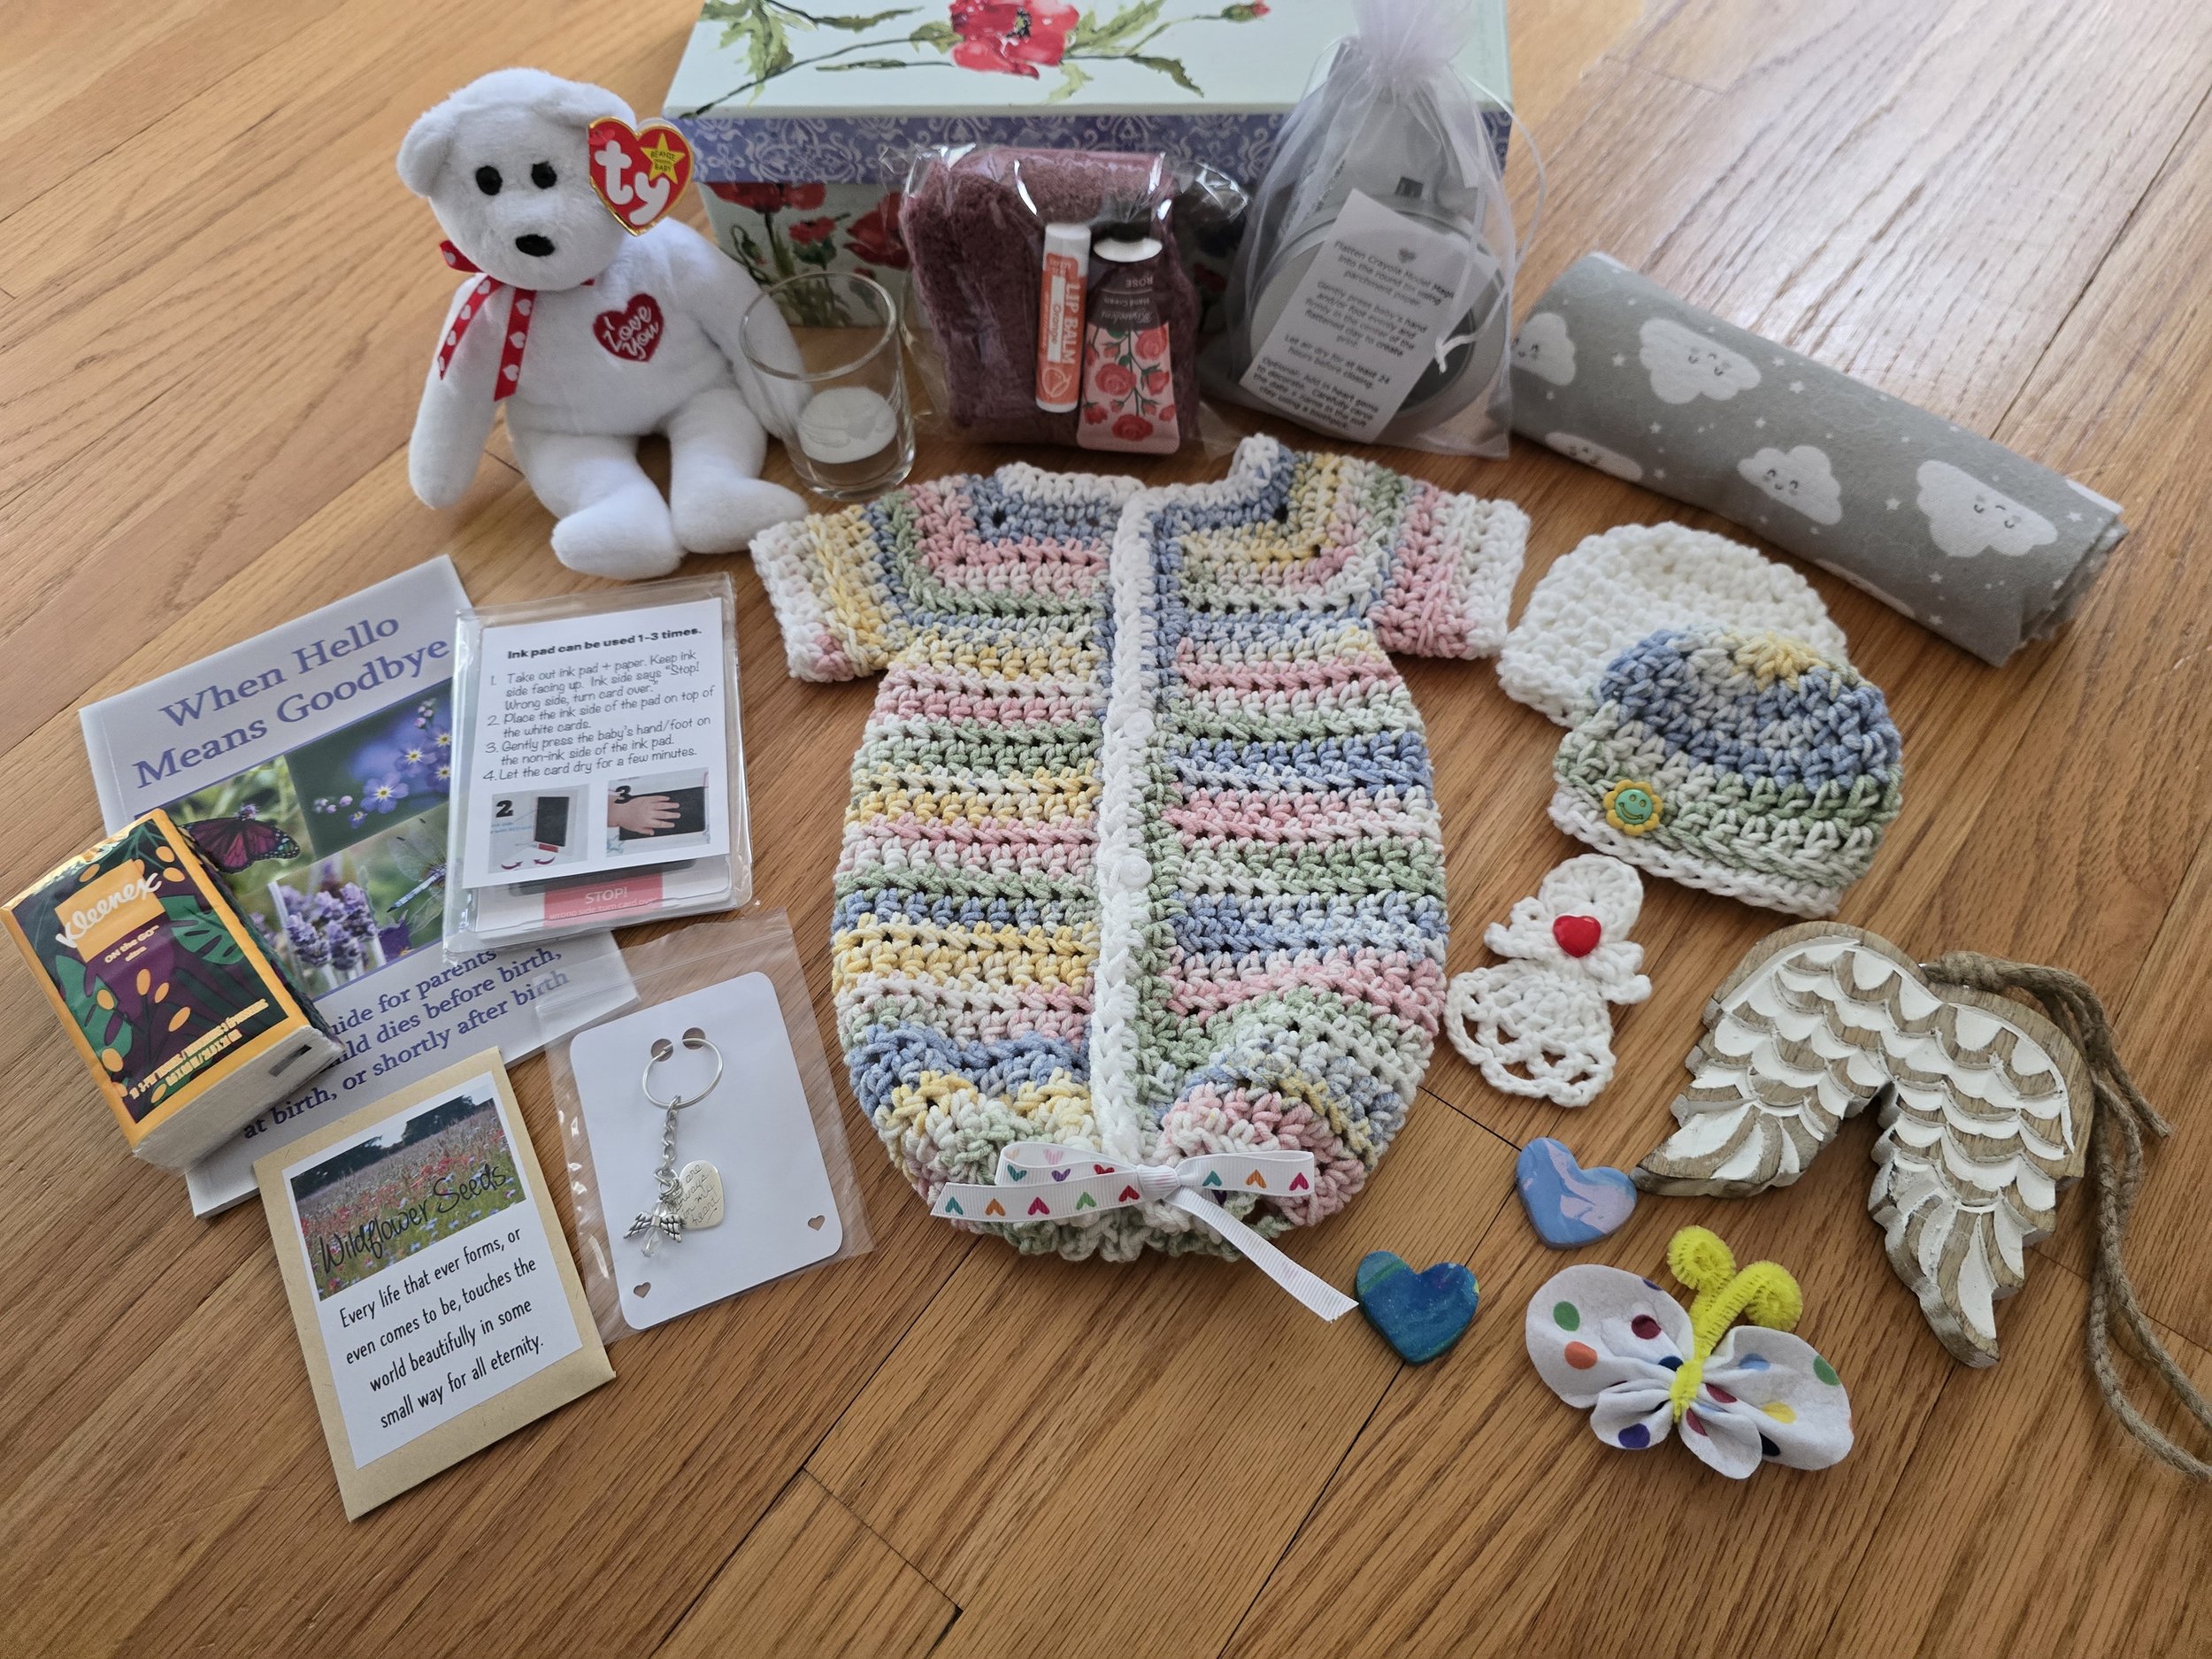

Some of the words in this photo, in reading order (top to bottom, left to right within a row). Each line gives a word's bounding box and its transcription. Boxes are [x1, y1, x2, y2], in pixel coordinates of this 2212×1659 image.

[595, 140, 670, 226] ty
[1065, 282, 1080, 314] LIP
[603, 306, 651, 352] Love
[1062, 316, 1079, 364] BALM
[506, 671, 535, 684] Take
[537, 669, 557, 680] out
[558, 664, 576, 678] ink
[578, 661, 599, 679] pad
[613, 658, 647, 673] paper.
[649, 653, 678, 665] Keep
[680, 648, 697, 661] ink
[507, 649, 528, 659] Ink
[529, 644, 556, 659] pad
[557, 643, 582, 653] can
[583, 641, 601, 649] be
[602, 634, 636, 647] used
[660, 627, 702, 640] times.
[157, 667, 288, 726] When
[290, 618, 399, 675] Hello
[504, 684, 528, 698] side
[531, 681, 566, 695] facing
[567, 680, 583, 692] up.
[589, 674, 608, 687] Ink
[610, 671, 634, 685] side
[634, 669, 662, 681] says
[131, 718, 268, 789] Means
[275, 640, 450, 723] Goodbye
[503, 698, 541, 711] Wrong
[543, 693, 570, 707] side,
[572, 692, 596, 703] turn
[597, 684, 624, 700] card
[503, 711, 536, 725] Place
[538, 709, 557, 720] the
[558, 705, 576, 718] ink
[578, 702, 602, 716] side
[603, 698, 619, 713] of
[619, 697, 638, 710] the
[640, 692, 661, 710] pad
[663, 694, 679, 704] on
[680, 690, 700, 703] top
[701, 684, 716, 698] of
[484, 741, 499, 754] 3.
[501, 737, 539, 753] Gently
[541, 735, 574, 751] press
[576, 731, 595, 743] the
[635, 717, 694, 735] hand/foot
[695, 716, 711, 726] on
[500, 754, 519, 766] the
[521, 748, 565, 764] non-ink
[568, 745, 592, 759] side
[594, 741, 610, 756] of
[610, 740, 628, 753] the
[631, 736, 649, 750] ink
[650, 733, 674, 749] pad.
[502, 726, 521, 739] the
[523, 723, 554, 736] white
[556, 718, 592, 733] cards.
[481, 769, 496, 781] 4.
[498, 768, 518, 780] Let
[521, 765, 541, 778] the
[542, 761, 571, 776] card
[572, 759, 593, 774] dry
[595, 757, 614, 770] for
[615, 757, 625, 766] a
[626, 751, 649, 765] few
[650, 747, 697, 761] minutes.
[54, 872, 163, 949] Kleenex
[585, 887, 628, 903] STOP!
[376, 1014, 421, 1044] dies
[425, 979, 495, 1019] before
[500, 947, 563, 983] birth,
[378, 988, 411, 1013] for
[416, 949, 497, 1000] parents
[244, 1118, 267, 1139] at
[269, 1087, 337, 1125] birth,
[342, 1070, 366, 1090] or
[373, 1028, 452, 1077] shortly
[458, 1000, 508, 1034] after
[513, 971, 569, 1006] birth
[319, 1199, 428, 1274] Wildflower
[432, 1163, 506, 1213] Seeds
[338, 1300, 375, 1328] Every
[377, 1284, 401, 1308] life
[403, 1269, 432, 1295] that
[433, 1256, 460, 1280] ever
[462, 1238, 504, 1265] forms,
[506, 1227, 520, 1243] or
[345, 1340, 376, 1364] even
[379, 1317, 420, 1347] comes
[421, 1307, 437, 1325] to
[438, 1296, 462, 1316] be,
[460, 1271, 512, 1304] touches
[512, 1256, 537, 1278] the
[369, 1356, 407, 1392] world
[407, 1323, 476, 1371] beautifully
[479, 1318, 495, 1335] in
[496, 1300, 533, 1325] some
[380, 1393, 414, 1429] small
[416, 1385, 443, 1409] way
[446, 1371, 466, 1393] for
[470, 1355, 488, 1380] all
[489, 1334, 544, 1371] eternity.
